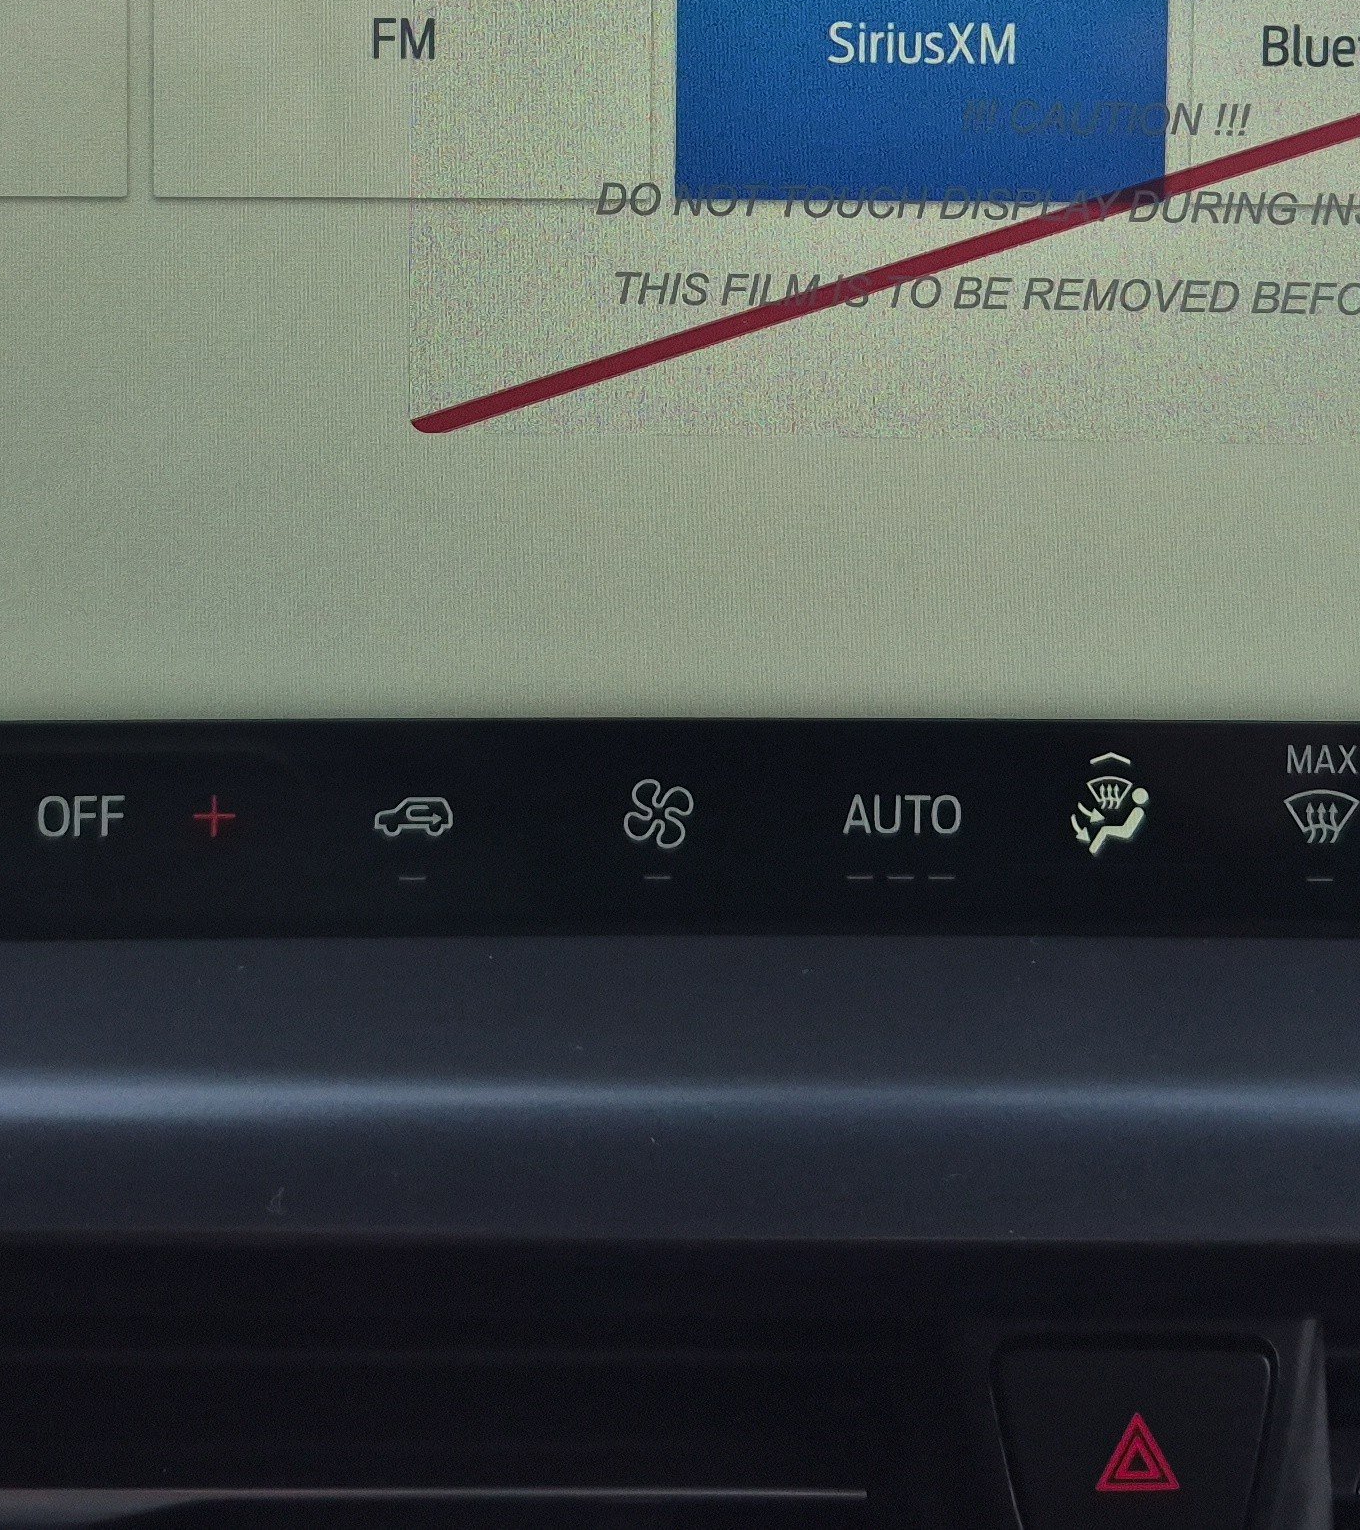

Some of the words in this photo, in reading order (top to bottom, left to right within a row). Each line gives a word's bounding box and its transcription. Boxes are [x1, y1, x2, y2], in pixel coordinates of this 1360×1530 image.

[371, 17, 437, 60] FM
[827, 21, 1018, 65] SiriusXM
[1008, 100, 1202, 136] CAUTION
[597, 181, 661, 216] DO
[673, 182, 762, 217] NOT
[779, 183, 928, 220] TOUCH
[940, 187, 1118, 222] DISPLAY
[1129, 190, 1298, 226] DURING
[614, 272, 708, 306] THIS
[721, 273, 823, 308] FILM
[883, 276, 942, 309] TO
[953, 277, 1015, 310] BE
[1022, 278, 1240, 314] REMOVED
[1285, 744, 1358, 775] MAX
[37, 796, 125, 836] OFF
[843, 795, 962, 835] AUTO
